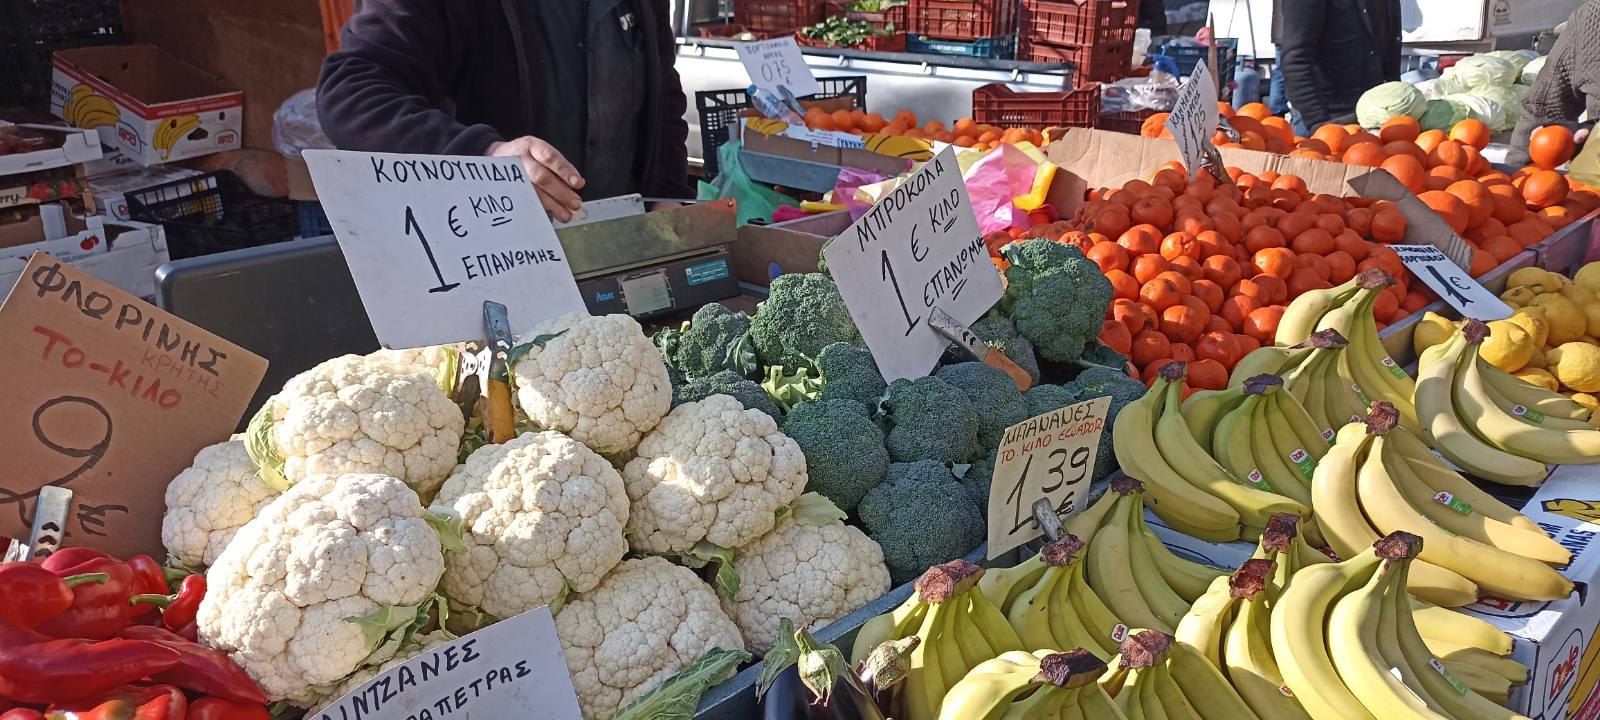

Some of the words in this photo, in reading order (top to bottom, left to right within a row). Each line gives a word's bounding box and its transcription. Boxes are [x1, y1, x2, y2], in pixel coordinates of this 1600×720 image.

[371, 156, 526, 183] ΚΟΥΝΟΥΠΙΔΙΑ
[856, 159, 944, 252] ΜΠΡΟΚΟΛΑ
[404, 205, 461, 293] 1
[448, 205, 468, 238] €
[469, 194, 514, 218] ΚΙΛΟ
[881, 249, 920, 336] 1
[910, 224, 928, 262] €
[928, 188, 959, 233] ΚΙΛΟ
[1425, 265, 1474, 307] 1
[1450, 276, 1471, 290] €
[32, 263, 227, 376] ΦΛΩΡΙΝΗΣ
[140, 351, 225, 399] ΚΡΗΤΗΣ
[1003, 402, 1095, 446] ΜΠΑΝΑΝΕΣ
[1022, 434, 1052, 456] ΚΙΛΟ
